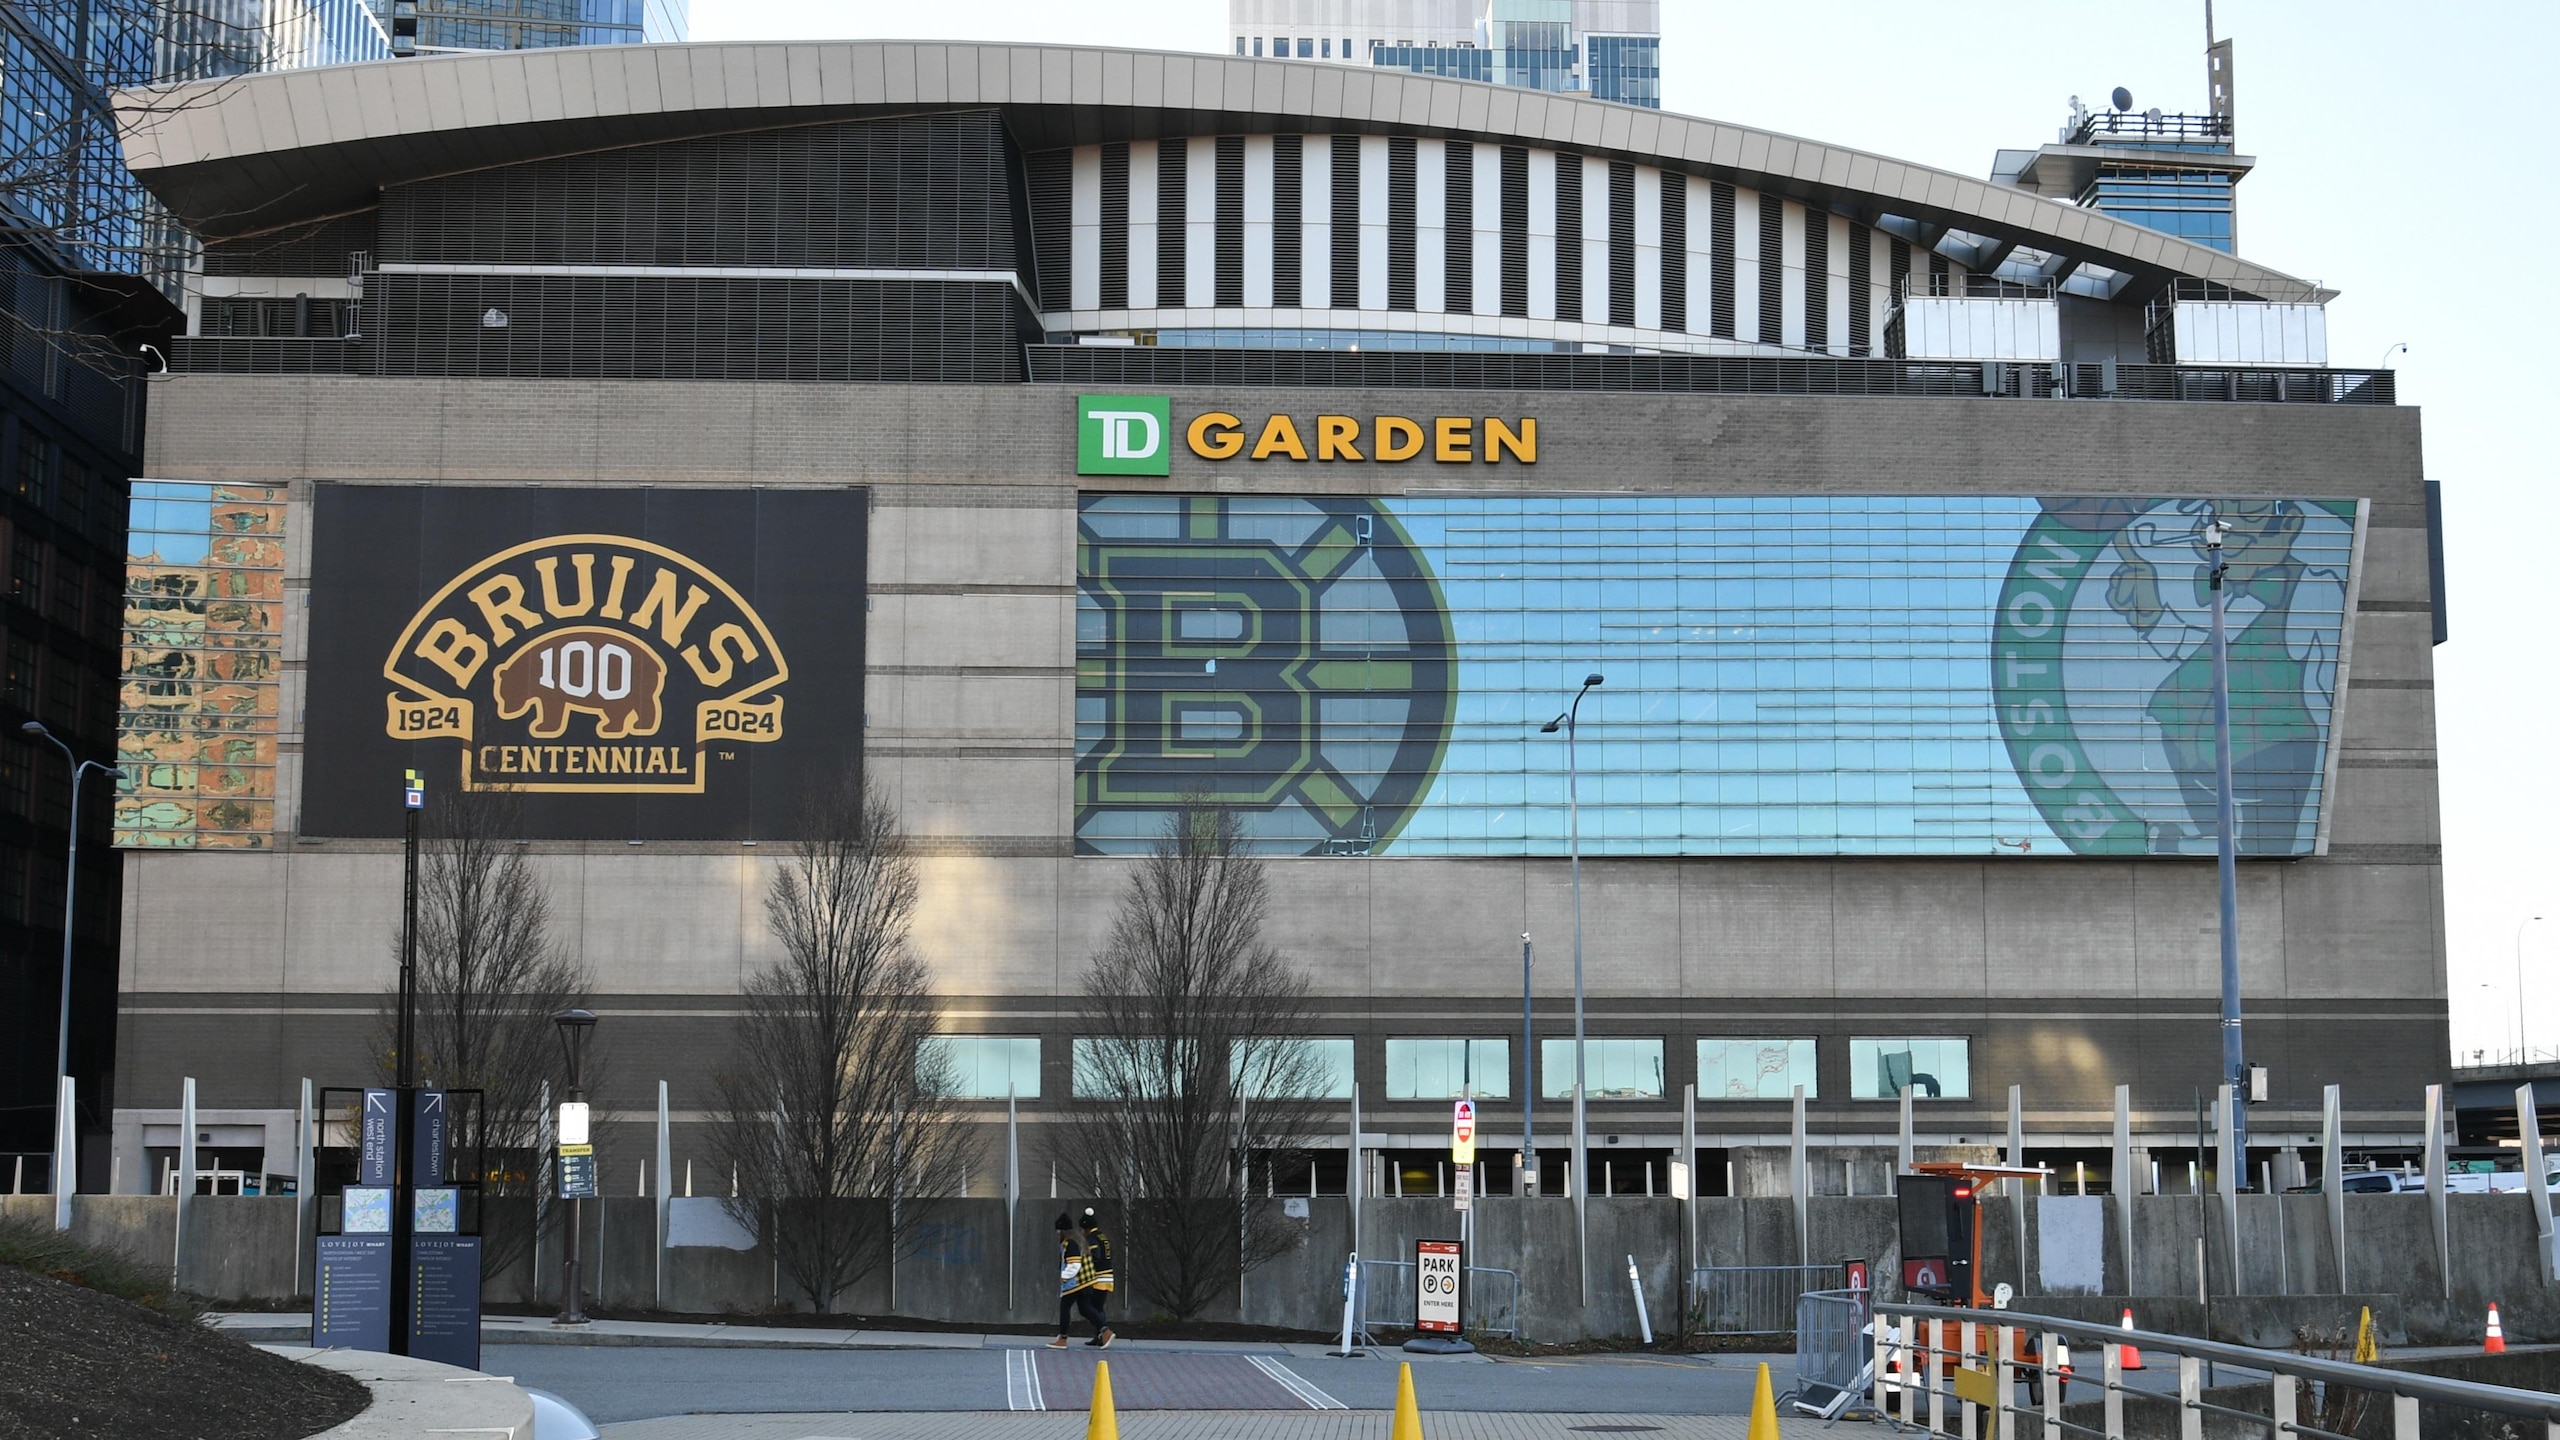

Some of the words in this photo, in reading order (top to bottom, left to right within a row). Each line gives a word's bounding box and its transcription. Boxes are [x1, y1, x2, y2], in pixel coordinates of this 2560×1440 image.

[1087, 410, 1161, 459] TD
[1185, 411, 1538, 463] GARDEN
[413, 552, 761, 691] BRUINS
[539, 640, 632, 701] 100
[2005, 534, 2119, 846] BOSTON
[398, 707, 461, 731] 1924
[704, 708, 775, 733] 2024
[479, 745, 688, 774] CENTENNIAL
[719, 751, 735, 761] TM
[366, 1118, 375, 1140] west
[376, 1118, 387, 1145] north
[366, 1141, 375, 1161] end
[431, 1118, 441, 1176] charlestown
[375, 1146, 386, 1179] station
[1423, 1258, 1454, 1272] PARK
